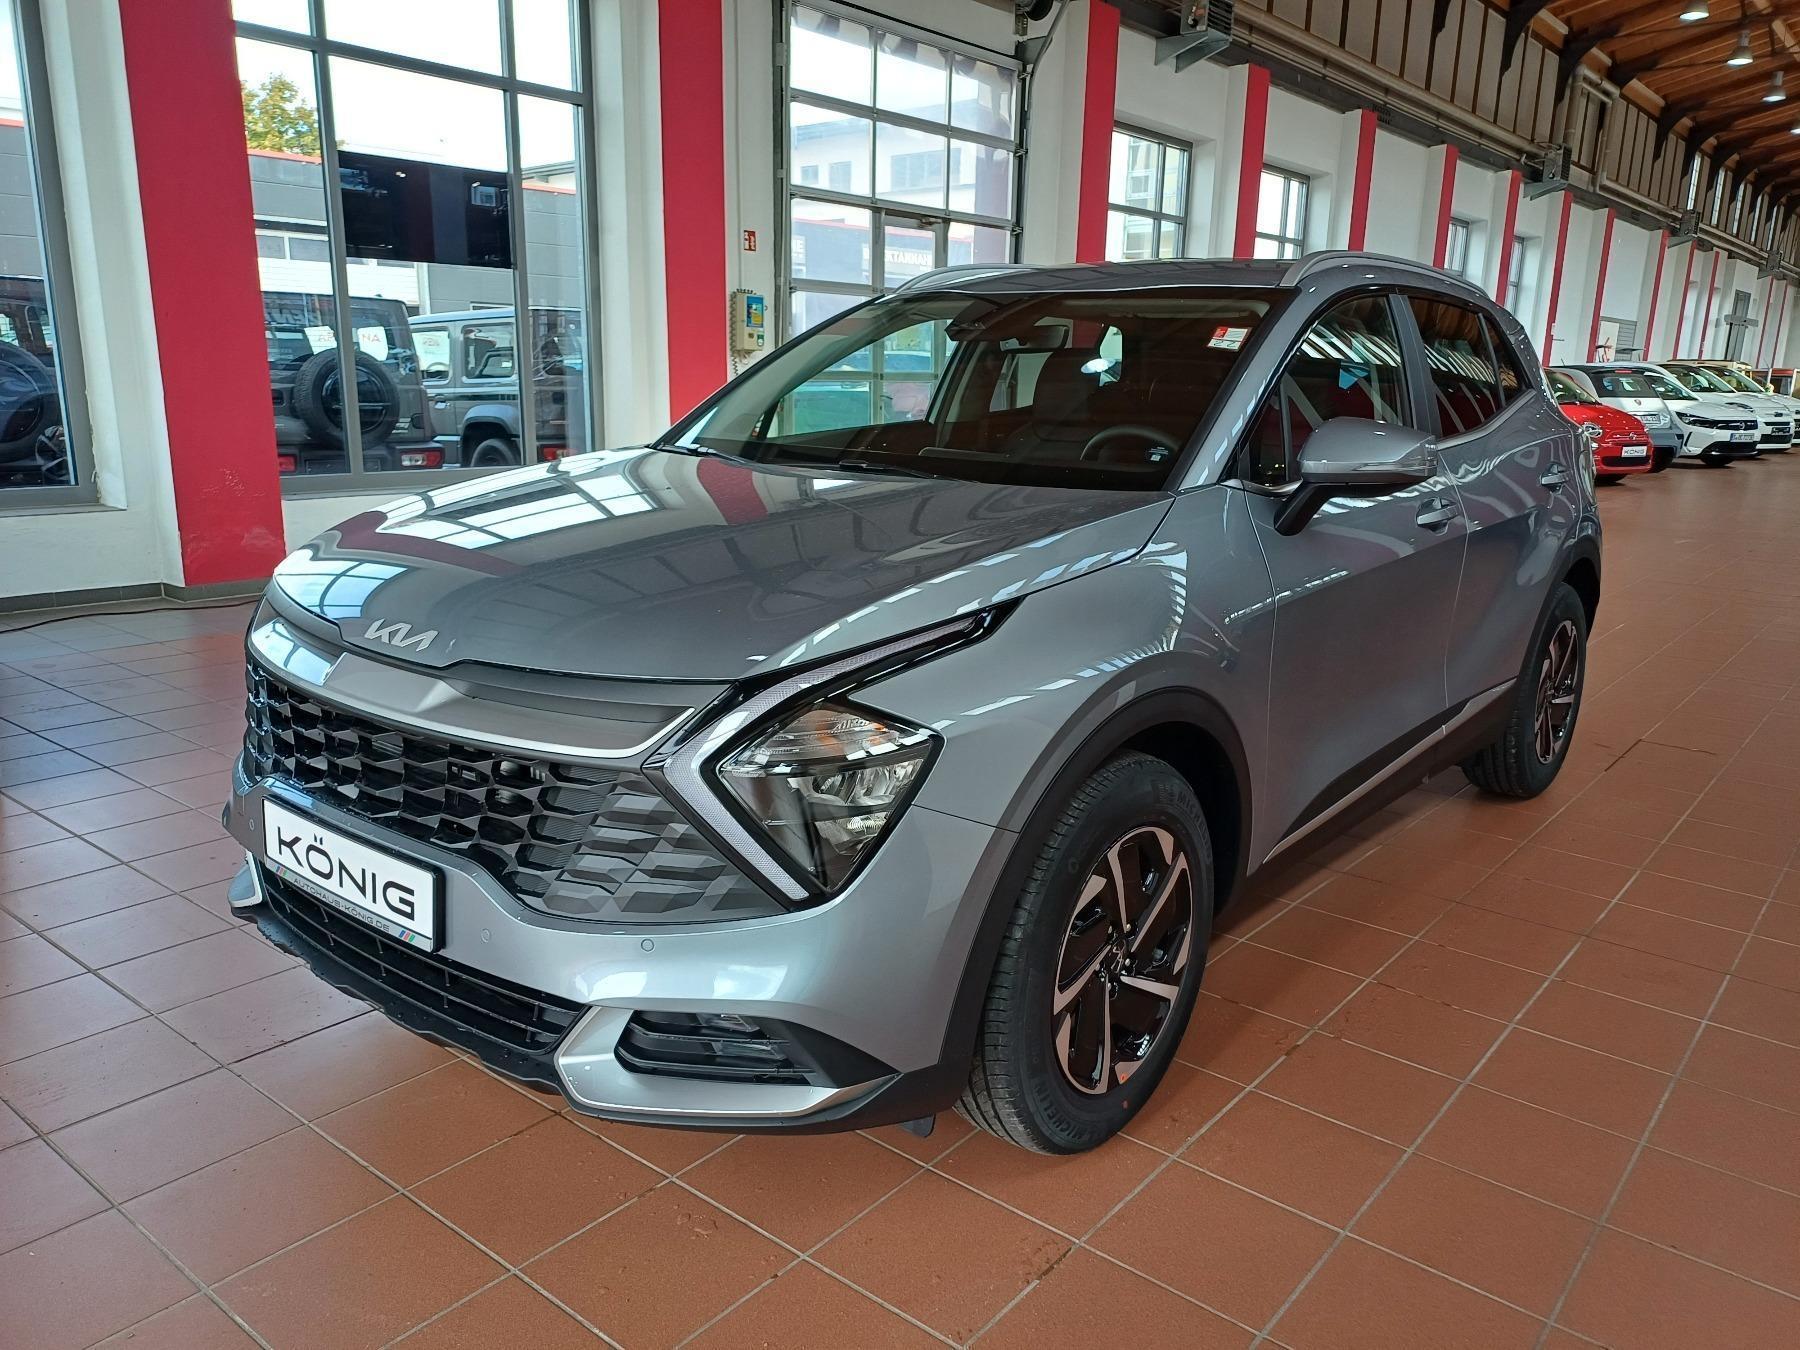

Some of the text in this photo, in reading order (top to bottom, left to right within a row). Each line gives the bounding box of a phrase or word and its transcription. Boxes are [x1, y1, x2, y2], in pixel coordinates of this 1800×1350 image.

[364, 618, 439, 652] KIA
[277, 826, 415, 922] KÖNIG
[293, 877, 390, 933] AUTOHAUS-KÖNIG.DE
